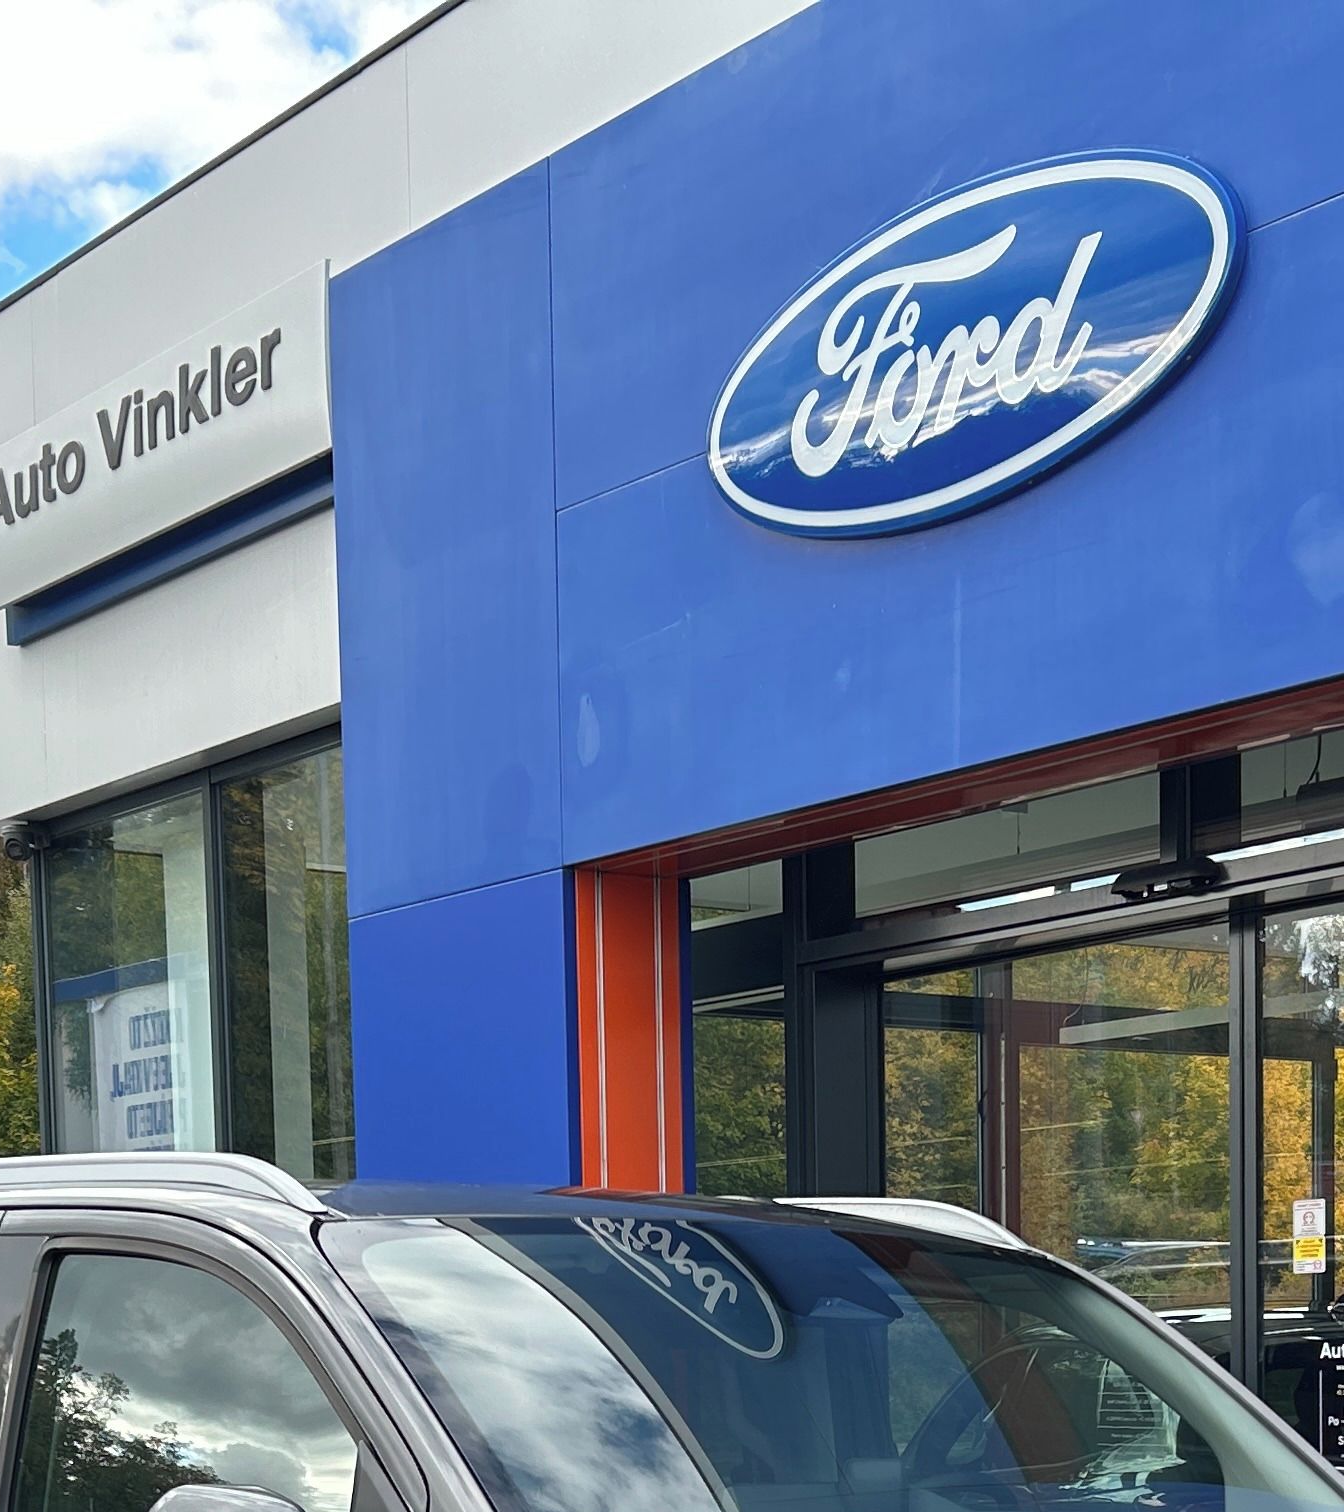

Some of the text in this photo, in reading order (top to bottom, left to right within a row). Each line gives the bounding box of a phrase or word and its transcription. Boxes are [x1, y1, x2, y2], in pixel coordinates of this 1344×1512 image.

[96, 327, 281, 470] Vinkler
[790, 223, 1102, 478] Ford
[1328, 1416, 1339, 1426] Po
